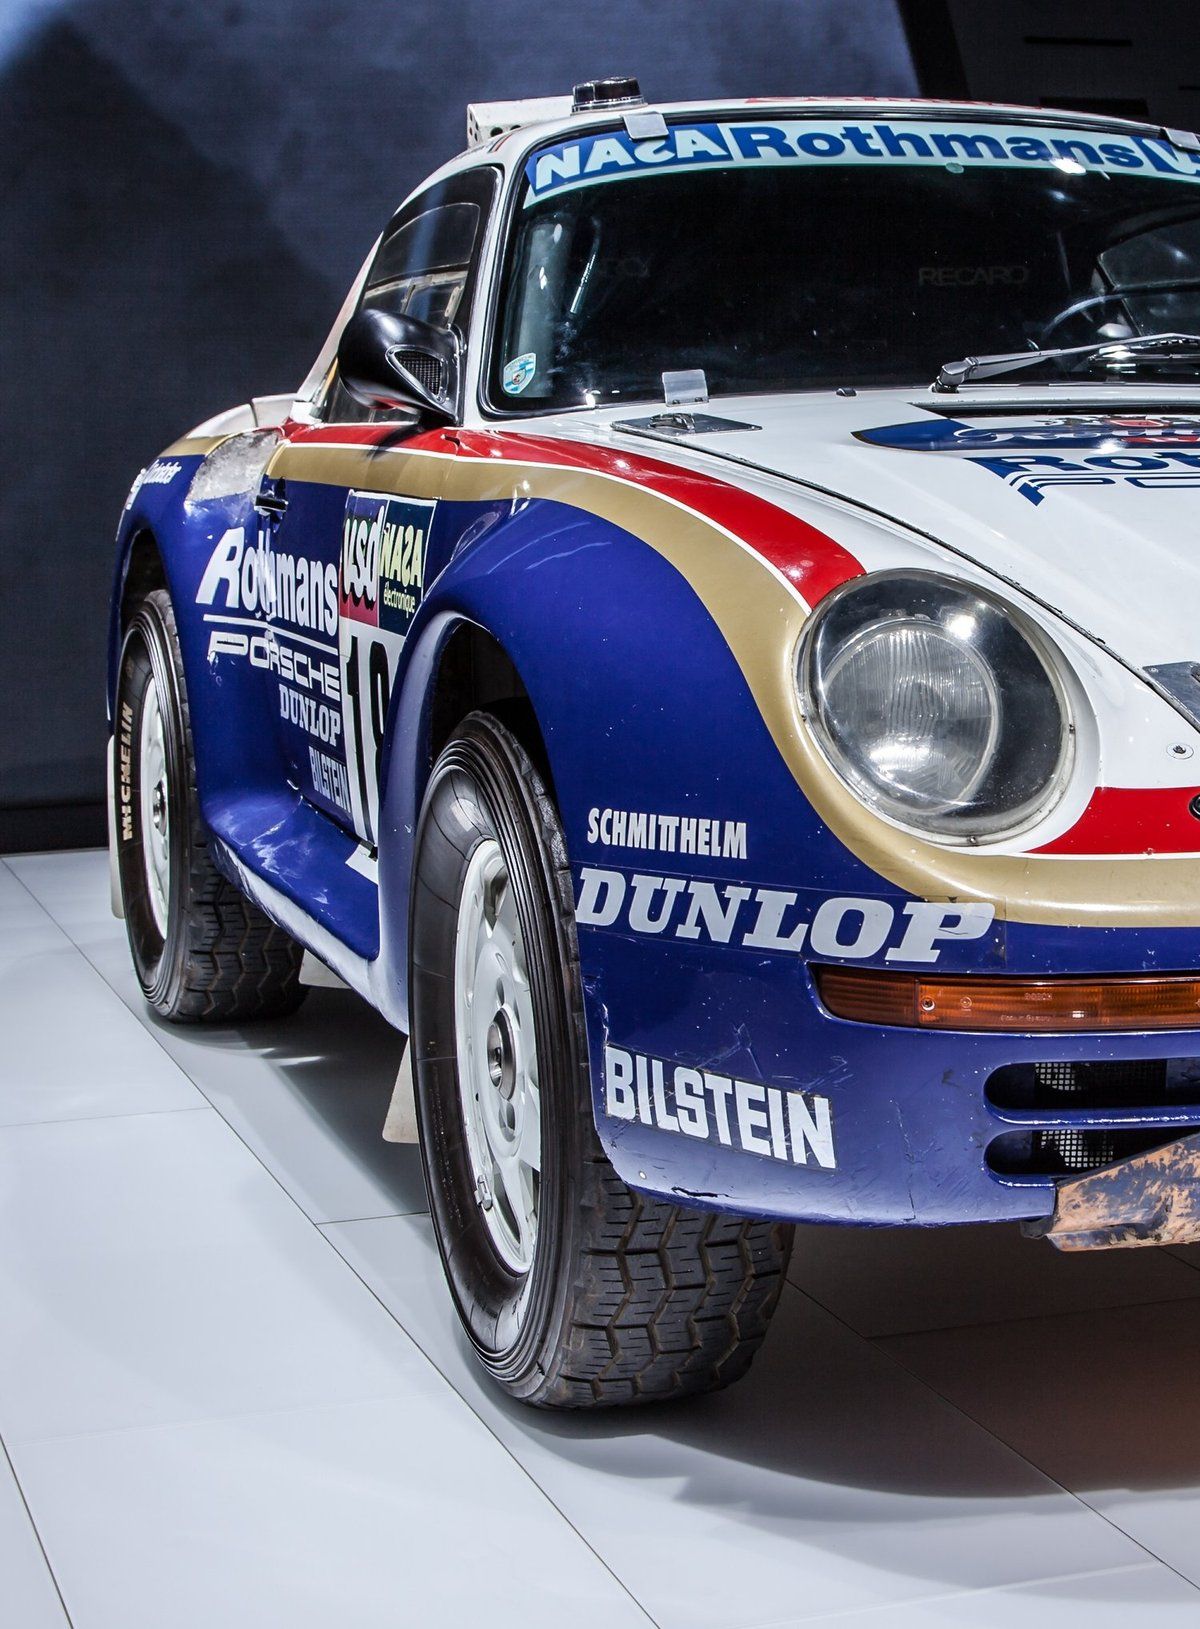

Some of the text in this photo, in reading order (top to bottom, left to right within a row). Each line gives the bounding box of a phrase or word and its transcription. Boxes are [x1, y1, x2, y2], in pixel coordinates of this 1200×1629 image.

[729, 124, 1144, 168] Rothmans
[918, 266, 1028, 286] RECARO
[195, 526, 339, 636] Rothmans
[207, 631, 341, 701] PORSCHE
[279, 683, 341, 747] DUNLOP
[120, 702, 134, 841] MICHELIN
[309, 745, 351, 814] BILSTEIN
[575, 868, 997, 963] DUNLOP
[606, 1046, 836, 1169] BILSTEIN
